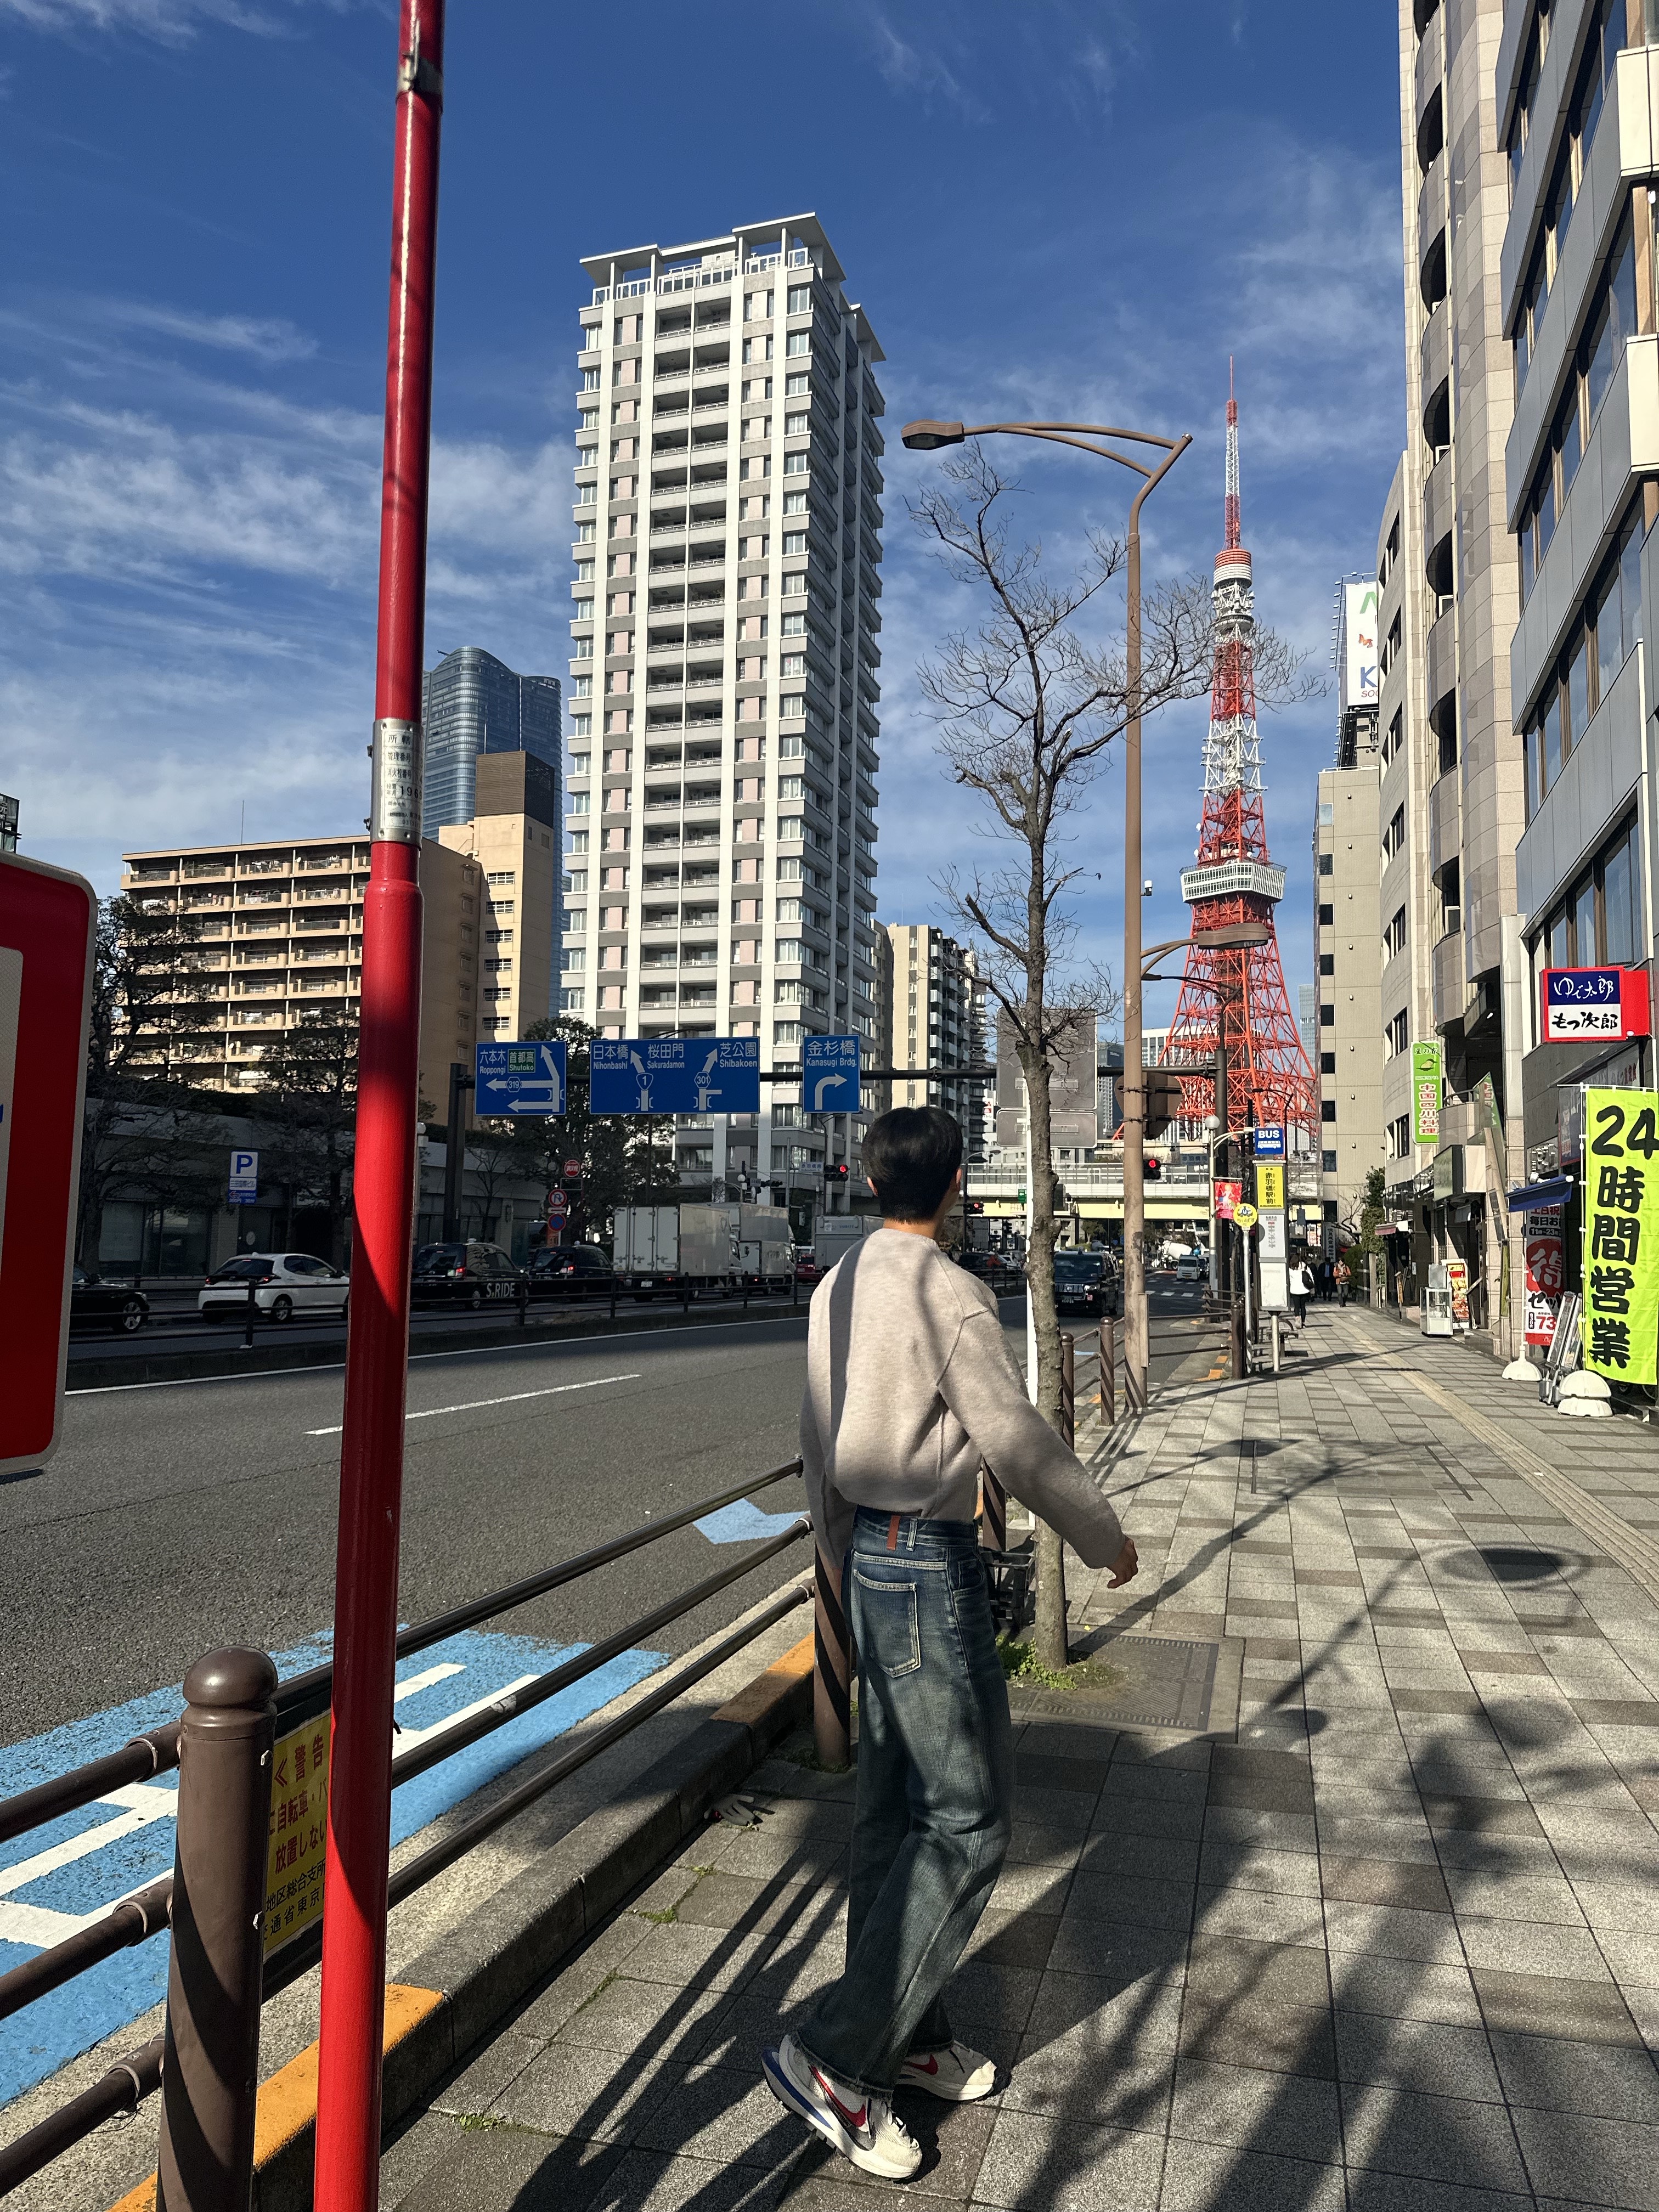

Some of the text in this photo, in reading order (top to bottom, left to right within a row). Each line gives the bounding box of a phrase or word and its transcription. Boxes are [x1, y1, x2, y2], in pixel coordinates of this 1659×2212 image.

[1554, 975, 1613, 1001] ゆで太郎
[1552, 1012, 1618, 1030] もつ次郎
[594, 1045, 629, 1059] 日本橋
[648, 1043, 684, 1058] 桜田門
[720, 1042, 757, 1057] 芝公園
[808, 1040, 855, 1056] 金杉橋
[479, 1049, 506, 1064] 六本木
[509, 1051, 534, 1063] 首都高
[719, 1059, 757, 1068] Shibakoen
[806, 1058, 857, 1068] Kanasugi Brdg.
[479, 1066, 506, 1075] Roppongi
[593, 1061, 628, 1069] Nihonbashi
[647, 1060, 685, 1069] Sakuradamon
[508, 1080, 520, 1089] 319
[642, 1075, 647, 1086] 1
[696, 1076, 709, 1084] 301
[1419, 1084, 1439, 1134] 中国四川料理
[1258, 1130, 1280, 1138] BUS
[236, 1154, 253, 1174] P
[1265, 1172, 1273, 1204] 赤羽橋駅前
[486, 1283, 515, 1298] S.RIDE
